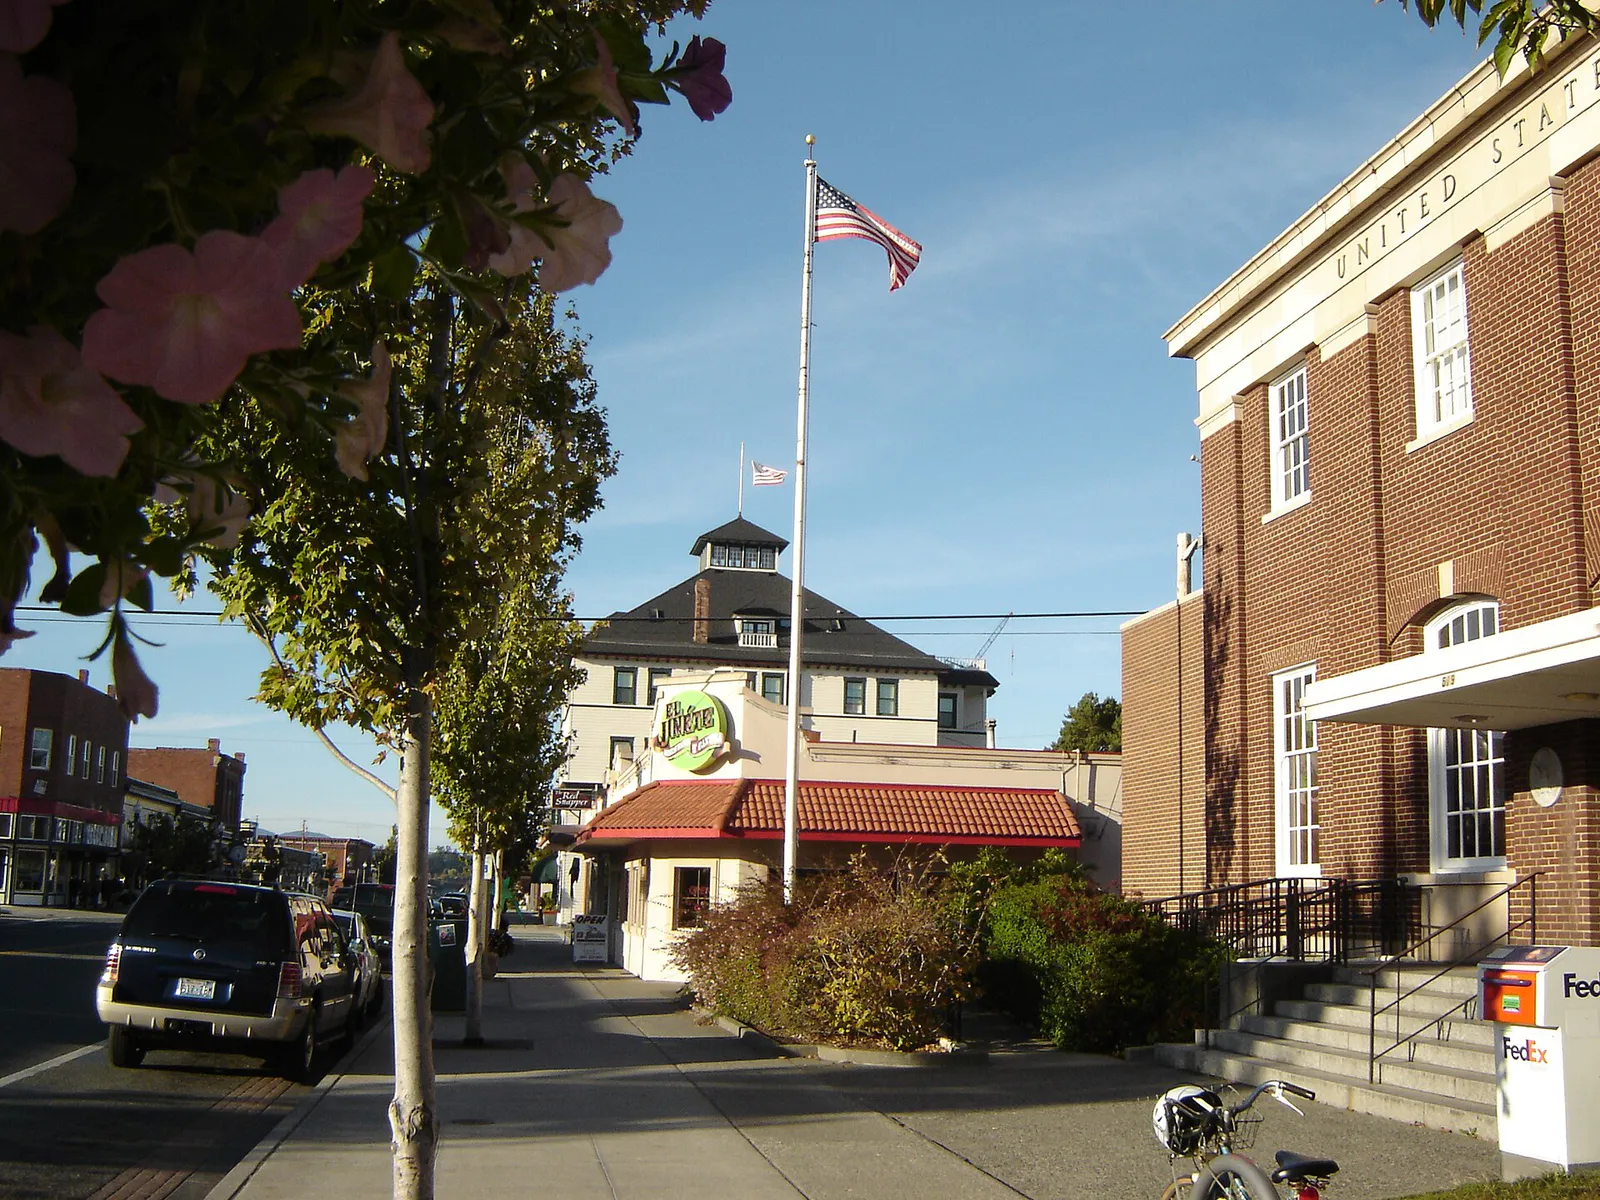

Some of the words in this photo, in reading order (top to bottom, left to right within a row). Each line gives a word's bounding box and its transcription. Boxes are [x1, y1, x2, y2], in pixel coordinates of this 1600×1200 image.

[1337, 174, 1457, 279] UNITED
[562, 791, 580, 800] Red
[555, 798, 589, 808] Snapper
[576, 915, 606, 924] OPEN
[1503, 1036, 1548, 1064] FedEx
